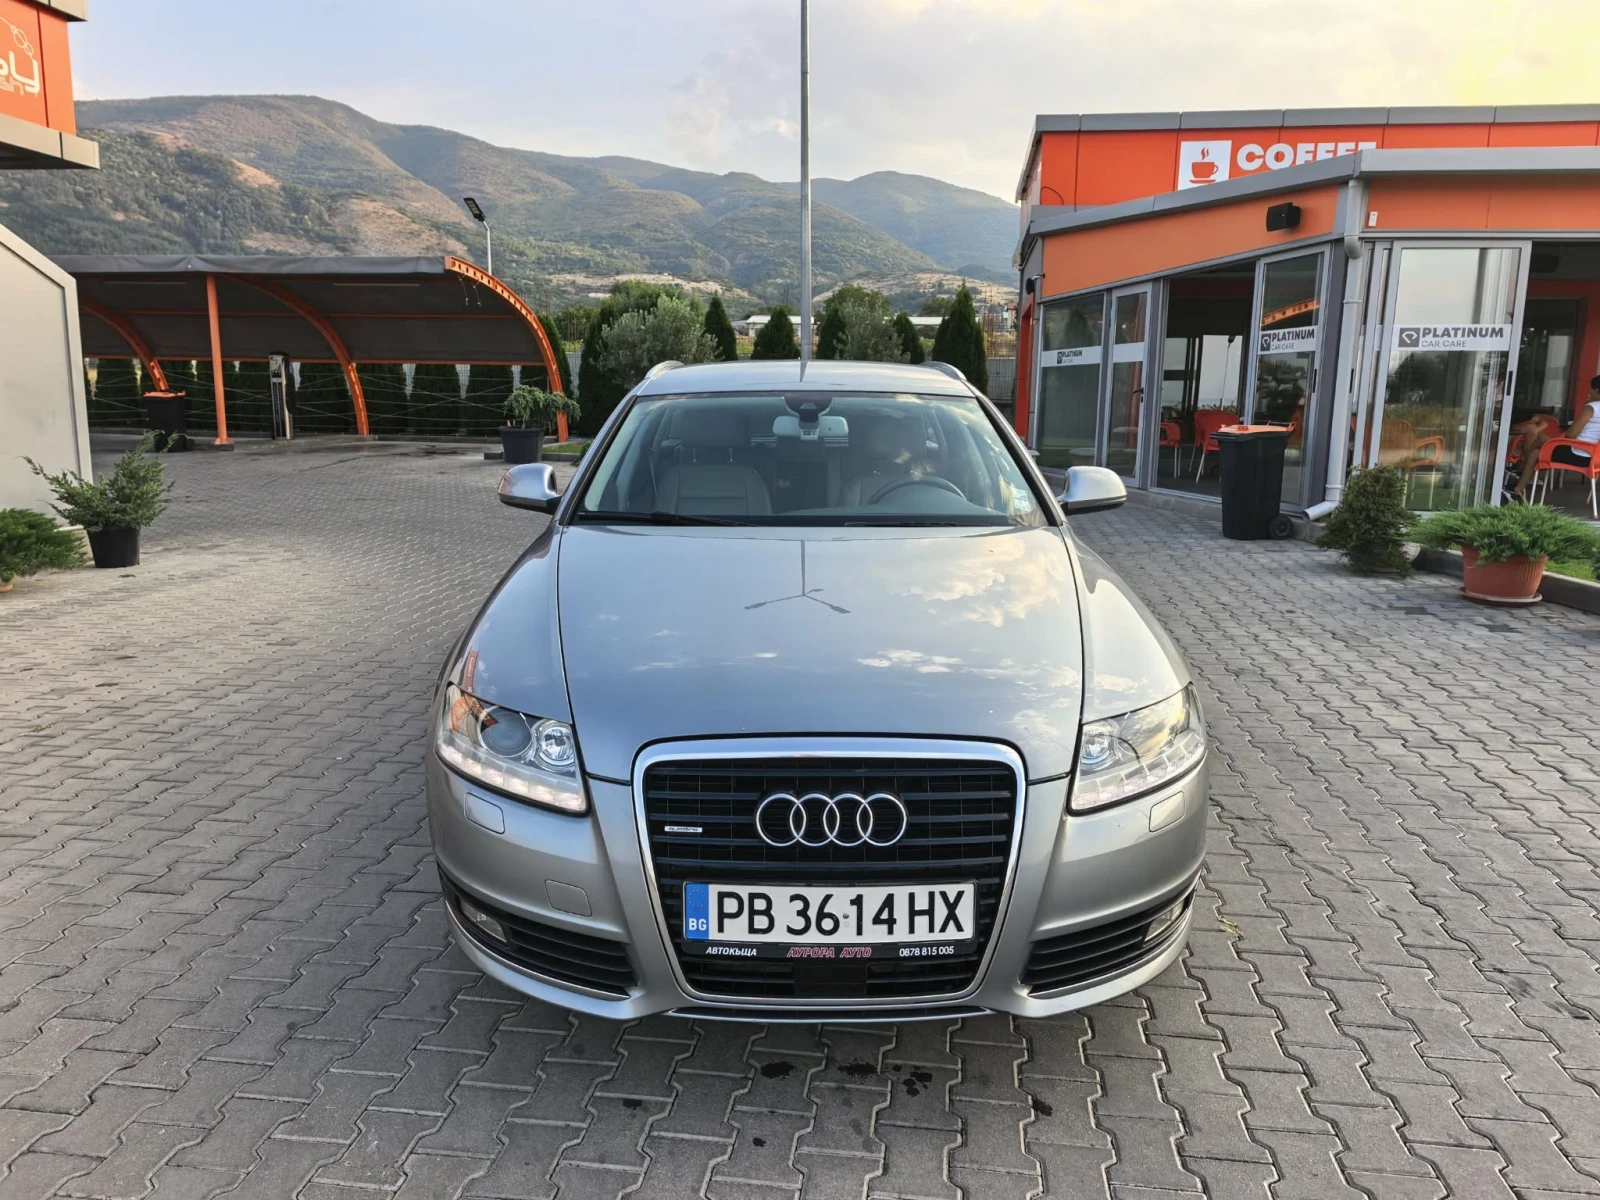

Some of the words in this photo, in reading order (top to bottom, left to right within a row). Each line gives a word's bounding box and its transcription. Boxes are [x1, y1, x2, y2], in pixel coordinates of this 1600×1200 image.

[1236, 141, 1377, 171] COFF
[1271, 328, 1315, 342] PLATINUM
[1421, 327, 1504, 339] PLATINUM
[1421, 340, 1440, 348] CAR
[1442, 340, 1467, 348] CARE
[1062, 350, 1082, 358] PLATINUM
[717, 890, 775, 935] PB
[786, 892, 897, 936] 3614
[908, 889, 966, 934] HX
[688, 918, 708, 931] BG
[786, 946, 835, 958] АУРОРА
[839, 946, 872, 958] АУТО
[898, 947, 920, 957] 0878
[920, 946, 937, 956] 815
[937, 945, 955, 955] 005
